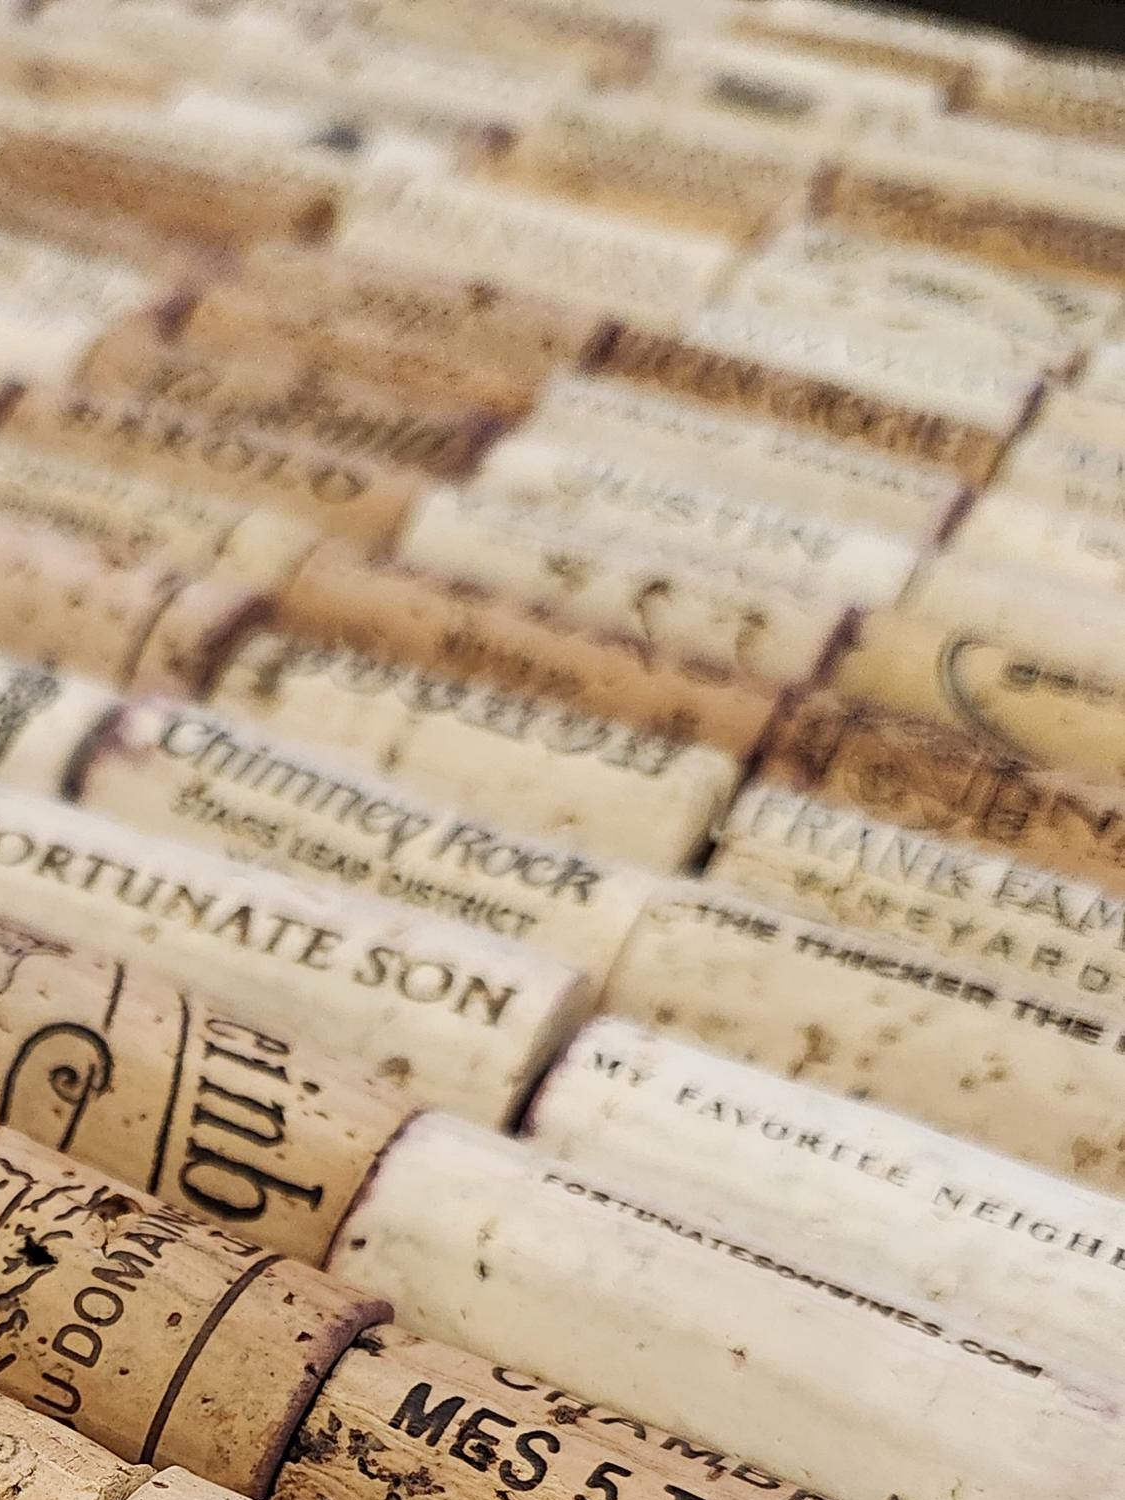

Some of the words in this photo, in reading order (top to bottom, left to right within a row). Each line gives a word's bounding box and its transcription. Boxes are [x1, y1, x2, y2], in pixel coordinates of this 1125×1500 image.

[159, 713, 432, 864] Chimney
[427, 822, 605, 908] Rock
[748, 788, 977, 902] FRANK
[381, 868, 545, 940] DISTRICT
[351, 943, 523, 1031] SON
[693, 900, 781, 946] THE
[794, 930, 999, 1010] THICKER
[1010, 996, 1106, 1047] THE
[587, 1050, 656, 1088] MY
[387, 1380, 564, 1492] MES
